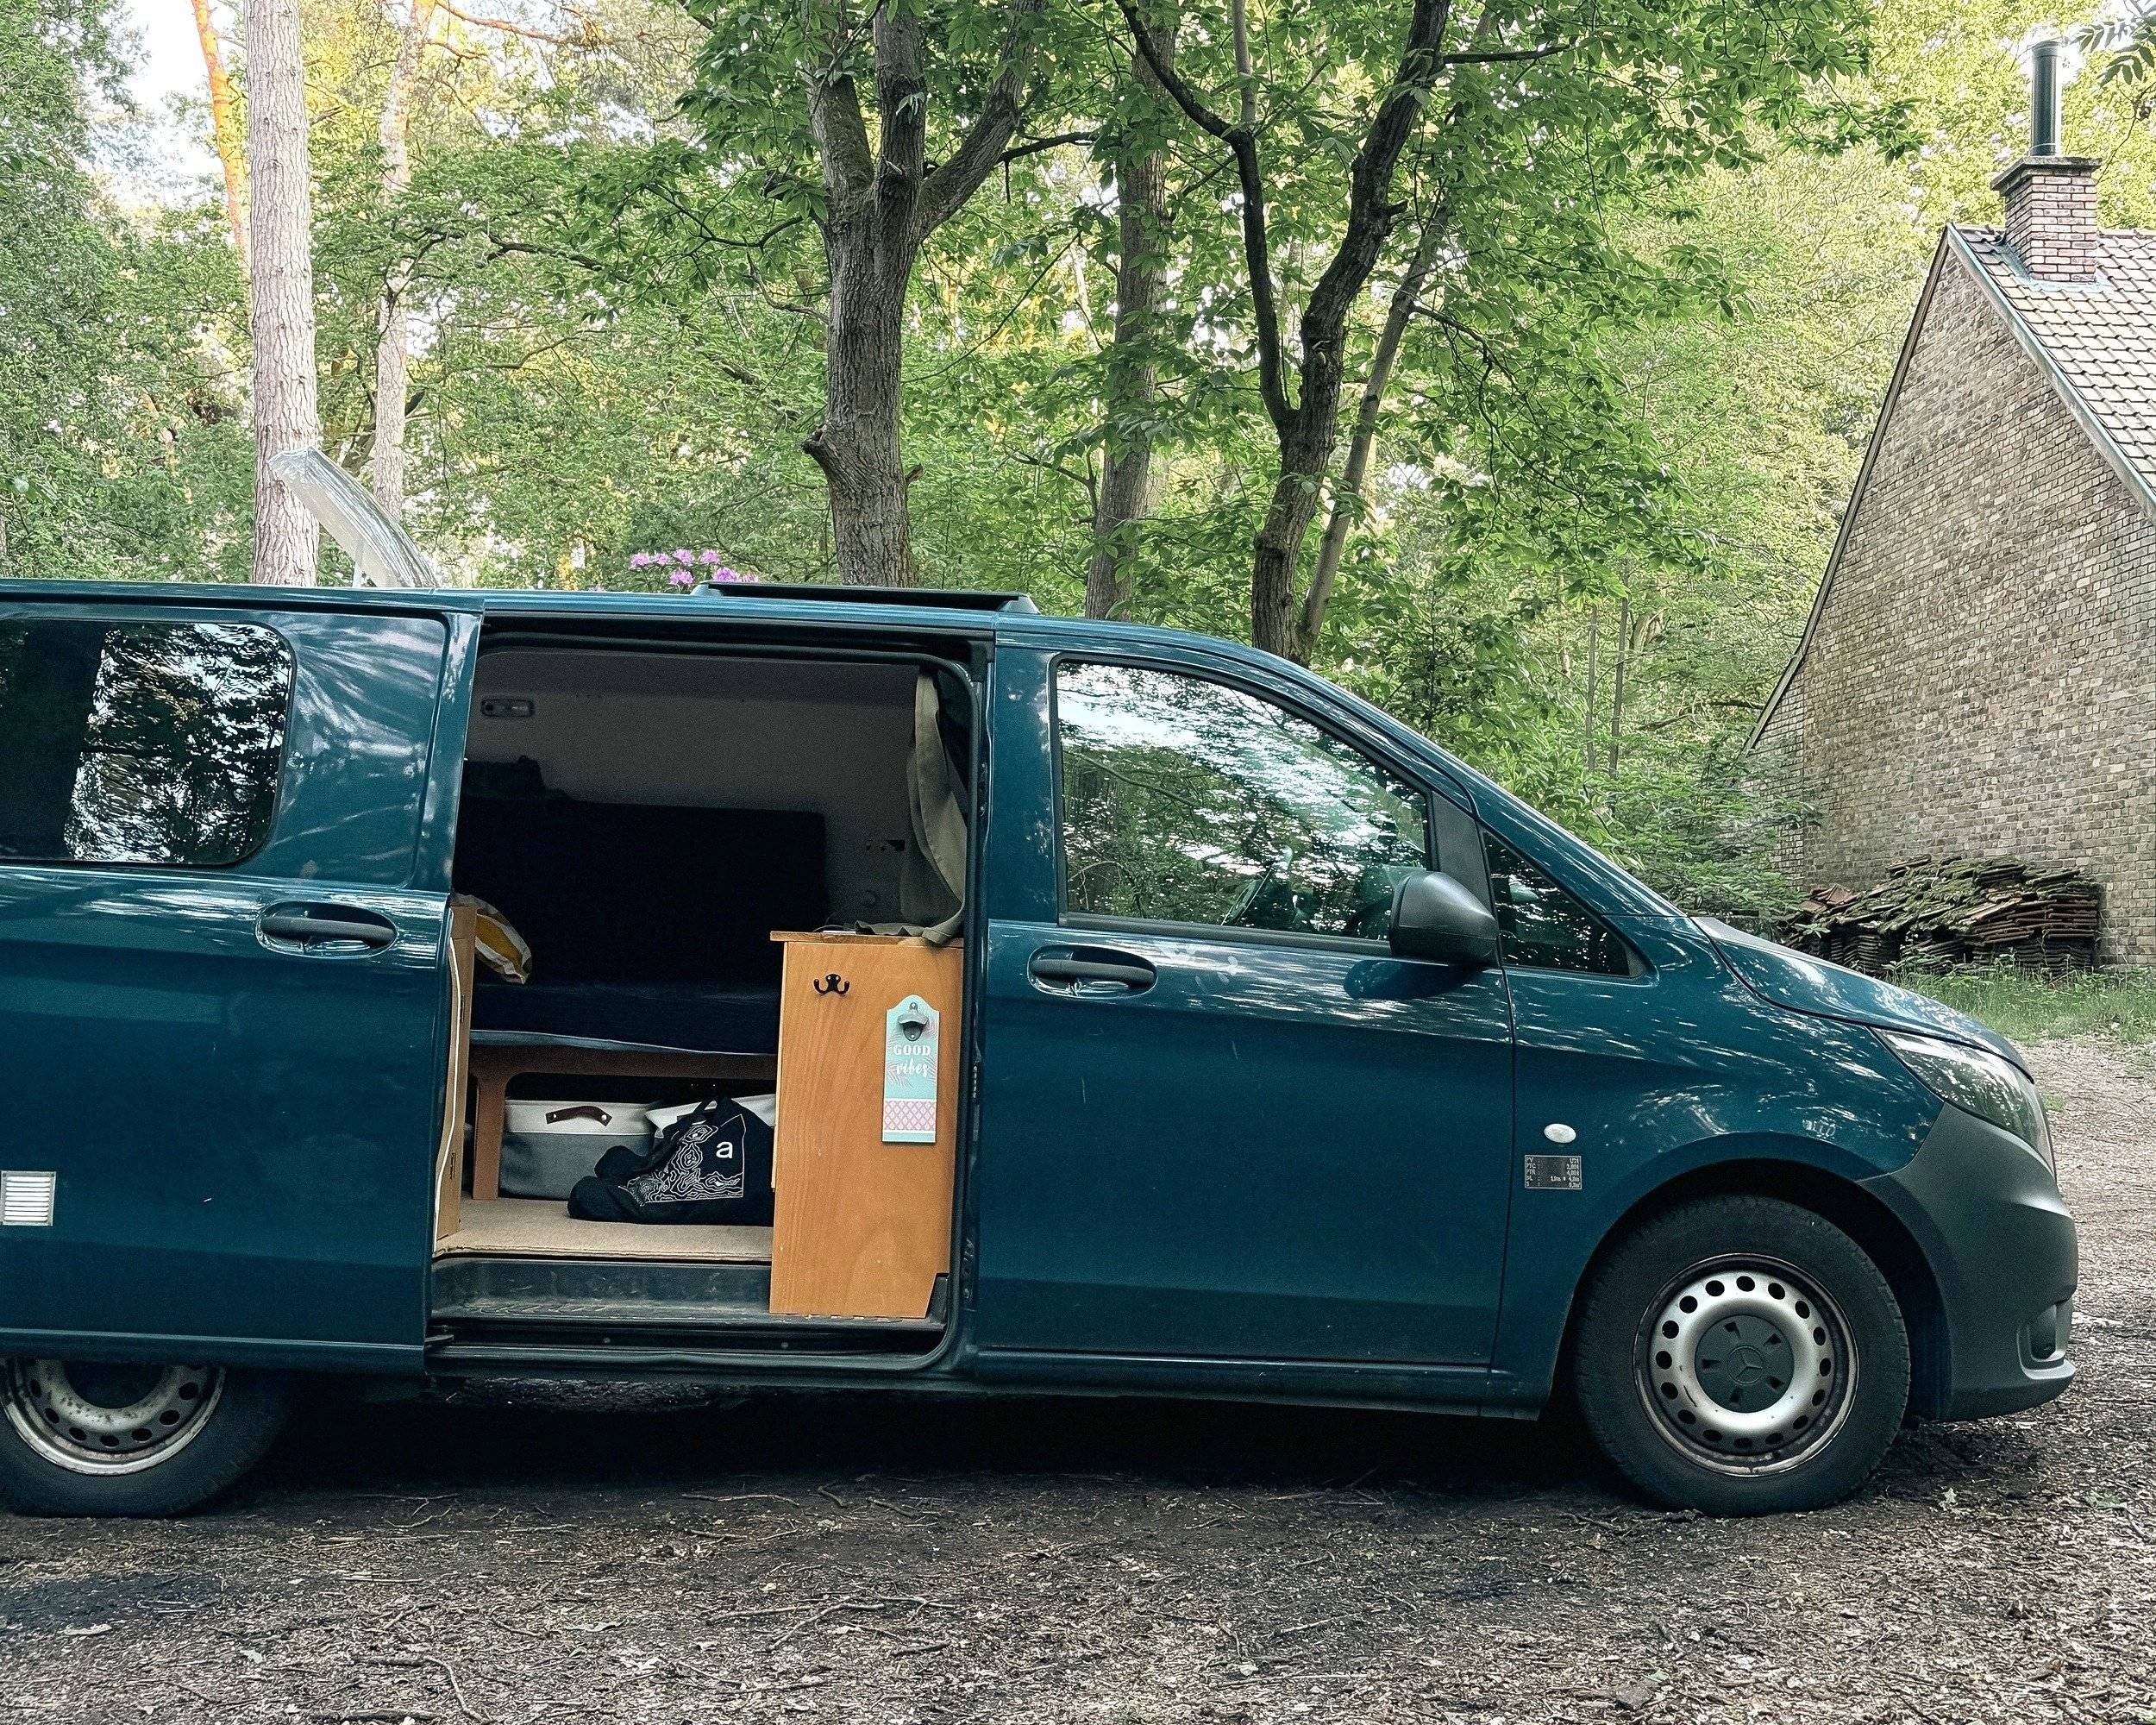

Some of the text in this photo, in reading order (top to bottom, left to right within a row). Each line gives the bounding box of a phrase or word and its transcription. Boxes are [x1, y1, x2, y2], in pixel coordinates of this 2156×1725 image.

[893, 1044, 931, 1056] GOOD
[896, 1057, 929, 1077] vibes
[716, 1141, 733, 1159] a
